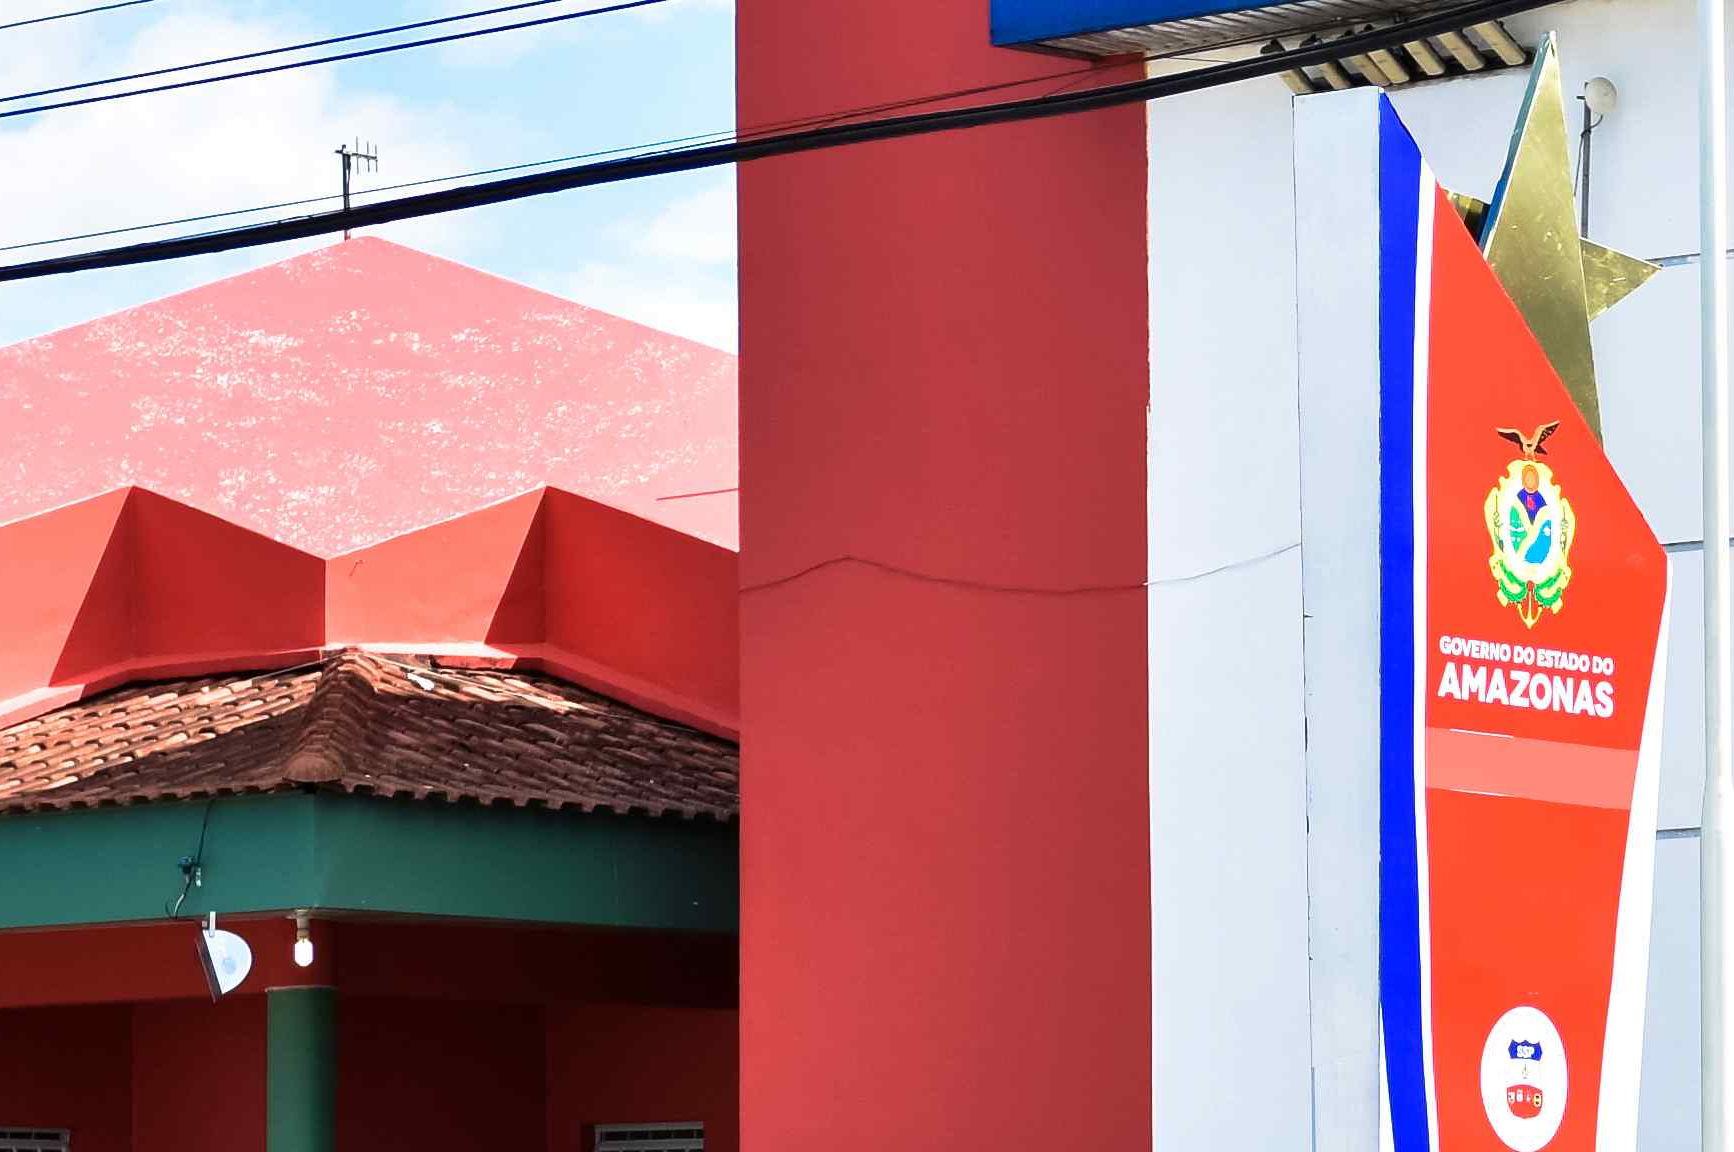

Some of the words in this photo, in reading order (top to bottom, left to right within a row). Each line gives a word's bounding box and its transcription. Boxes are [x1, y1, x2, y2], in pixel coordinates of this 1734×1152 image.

[1439, 636, 1511, 662] GOVERNO
[1513, 645, 1535, 665] DO
[1537, 649, 1590, 674] ESTADO
[1592, 656, 1614, 675] DO
[1437, 662, 1614, 718] AMAZONAS
